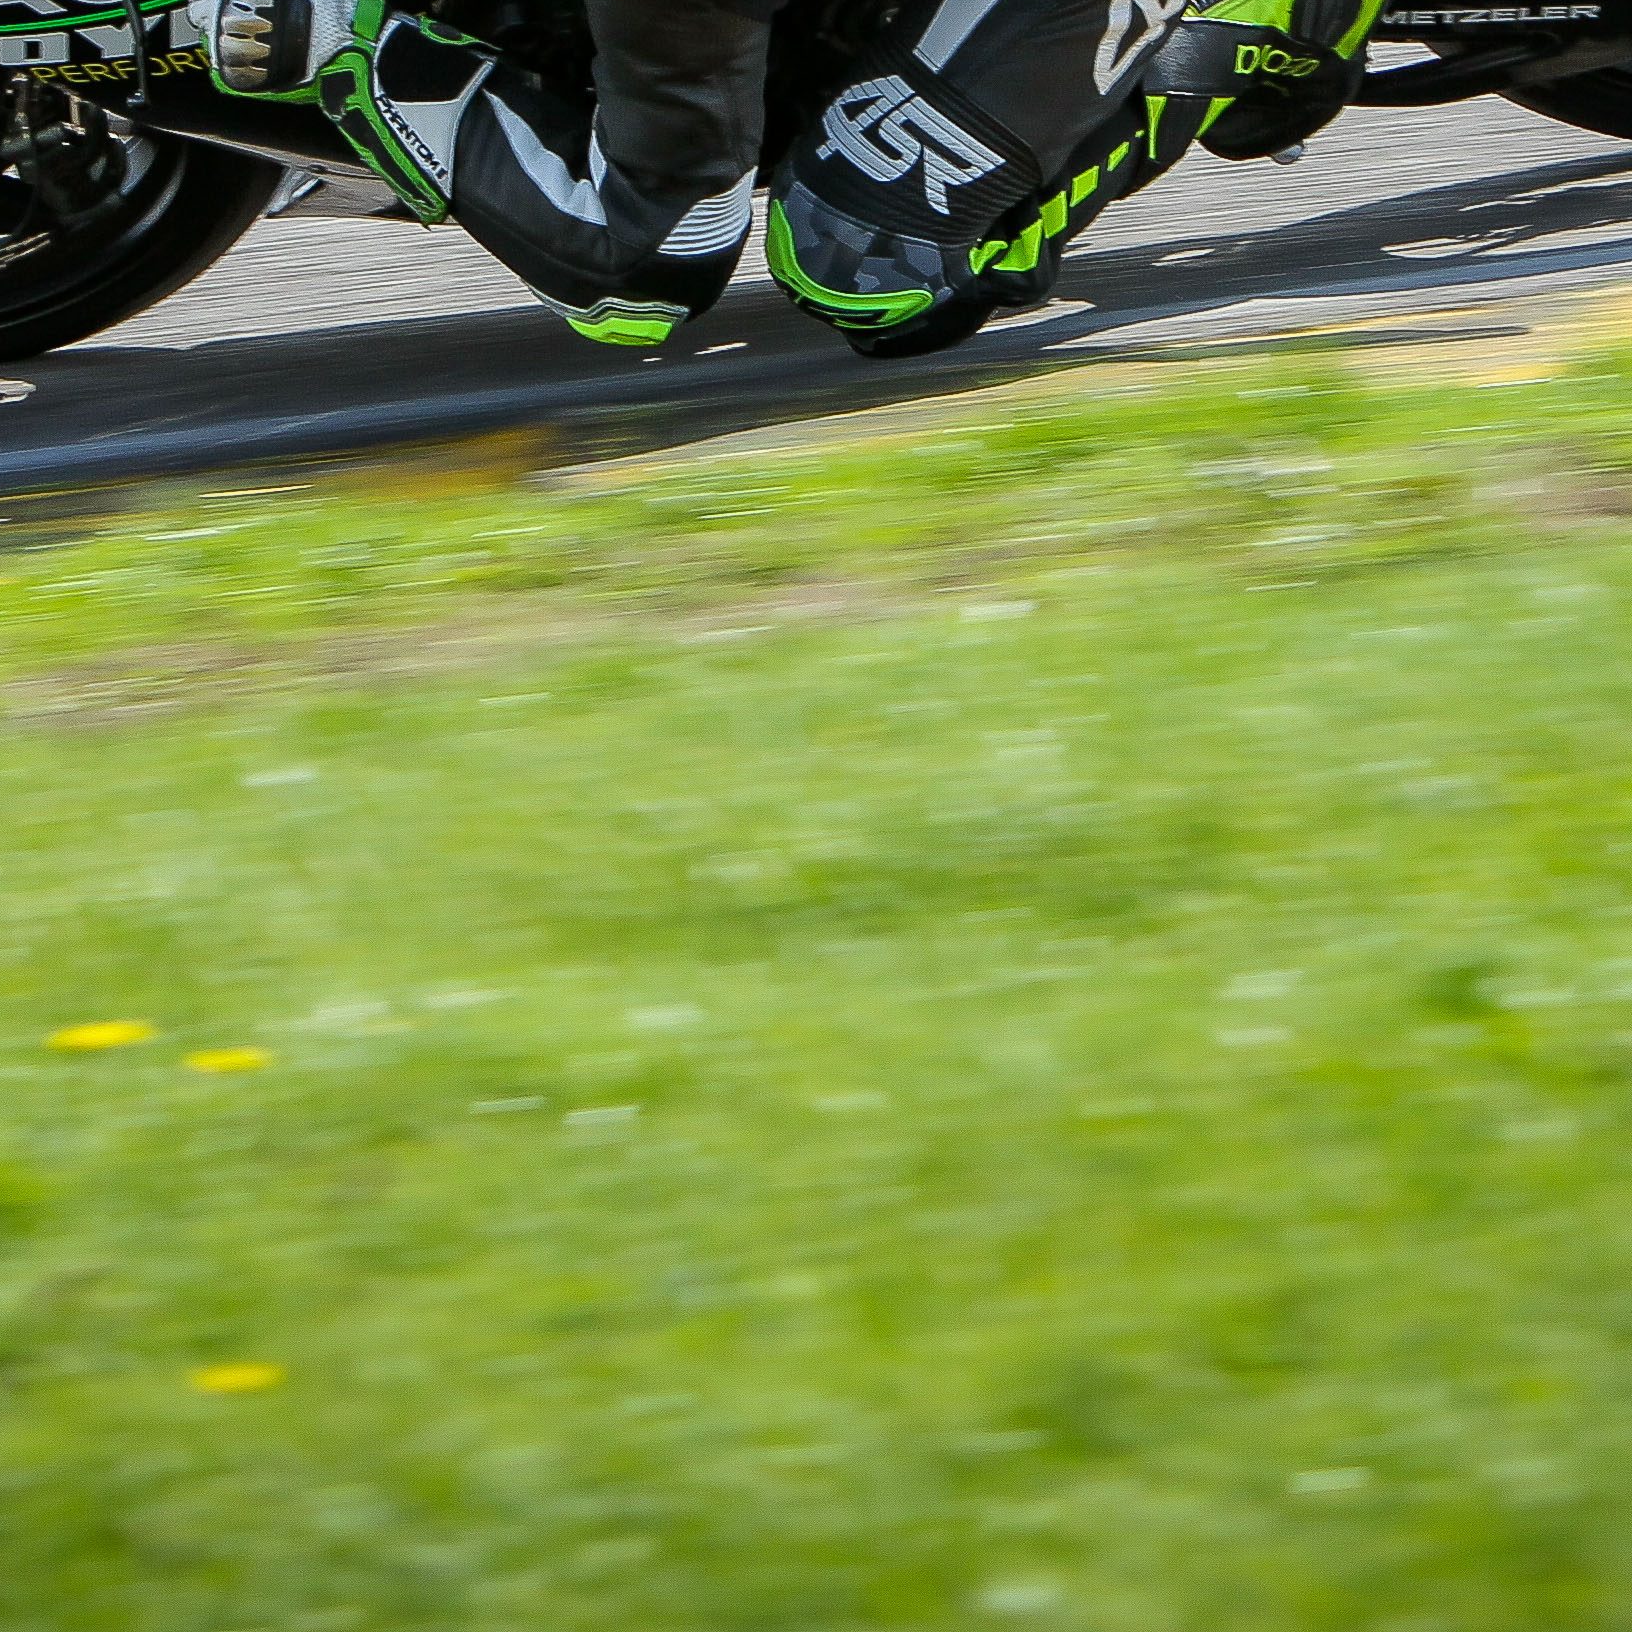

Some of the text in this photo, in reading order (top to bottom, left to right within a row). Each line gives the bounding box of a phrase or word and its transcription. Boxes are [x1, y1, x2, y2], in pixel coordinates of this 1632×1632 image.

[1380, 5, 1603, 24] METZELER
[375, 95, 440, 169] PHANTOM
[817, 74, 1006, 216] 4SR
